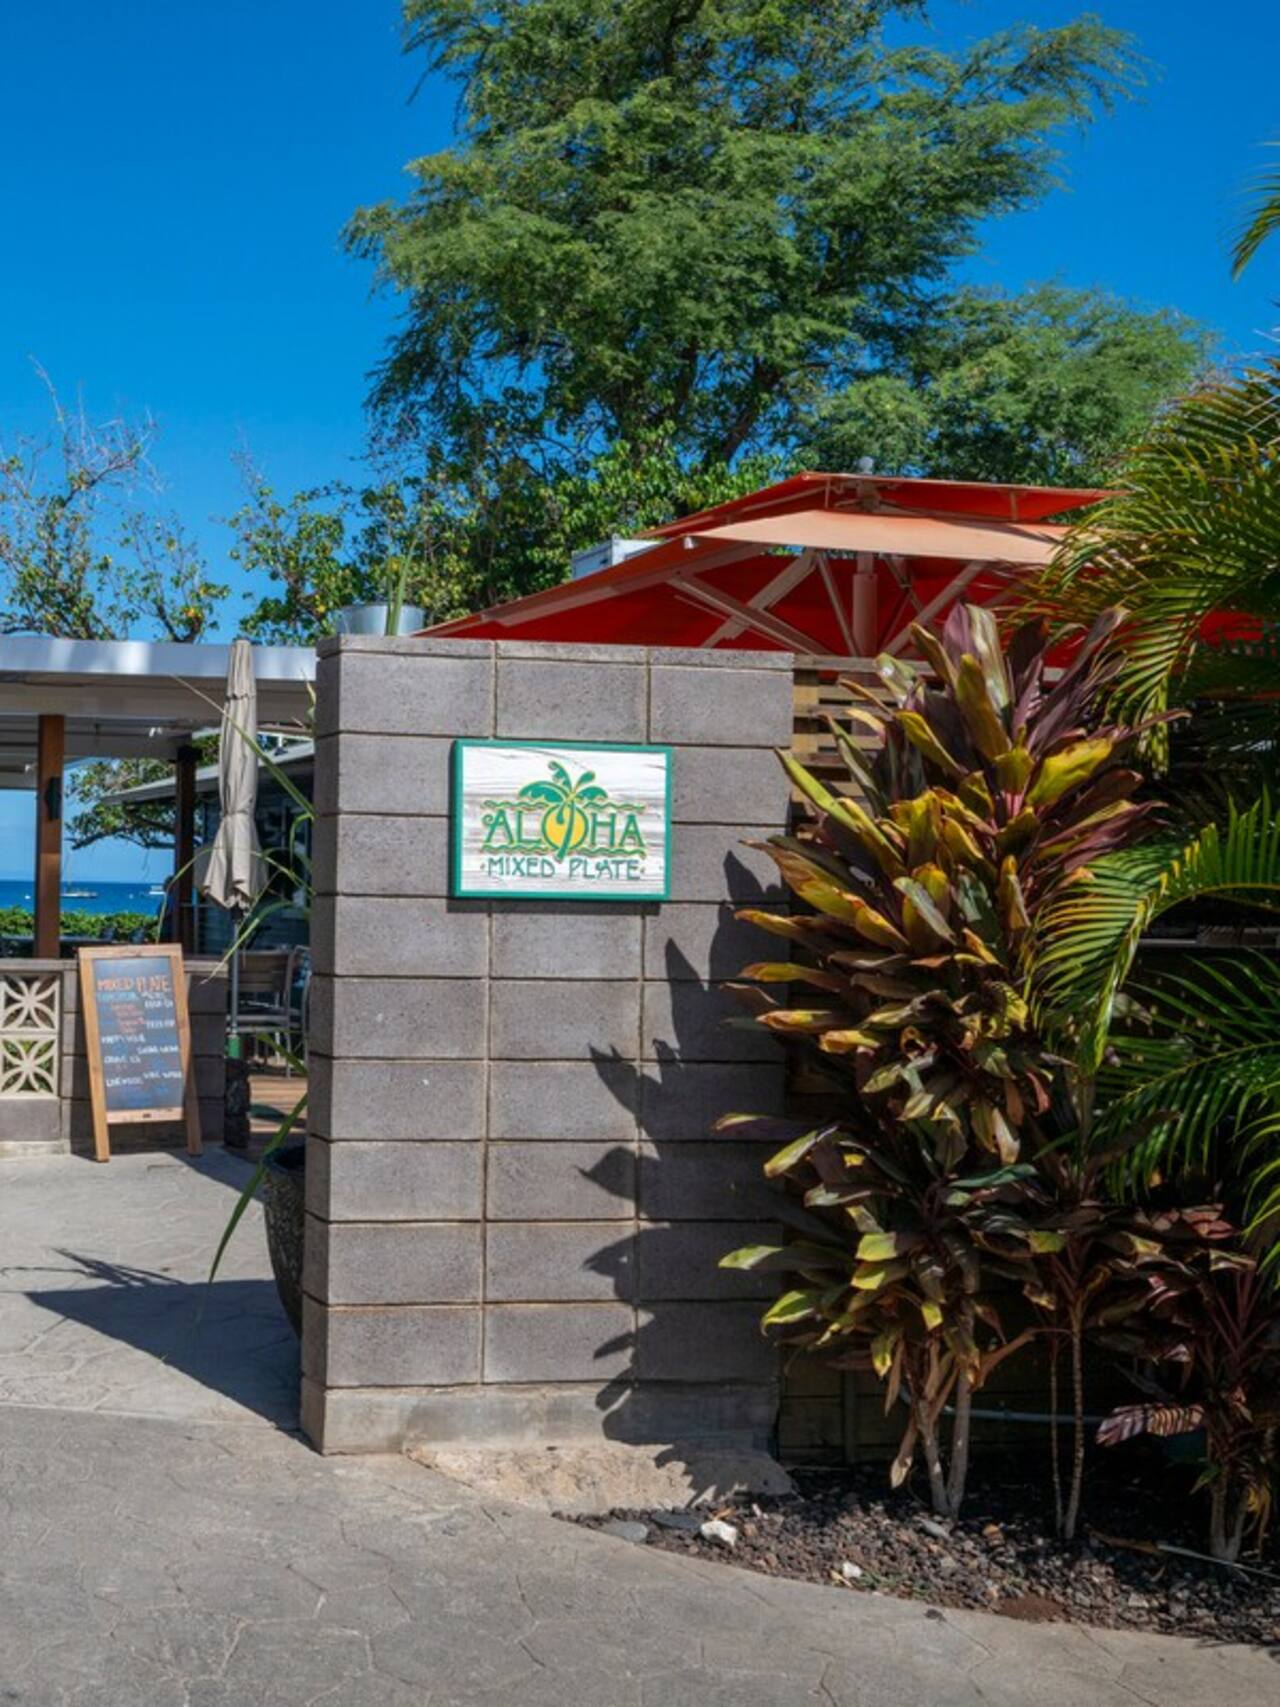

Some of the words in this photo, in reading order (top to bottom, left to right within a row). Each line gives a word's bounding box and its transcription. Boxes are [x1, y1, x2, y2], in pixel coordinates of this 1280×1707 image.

[482, 806, 646, 850] ALOHA
[487, 857, 555, 878] MIXED
[569, 858, 641, 881] PLATE
